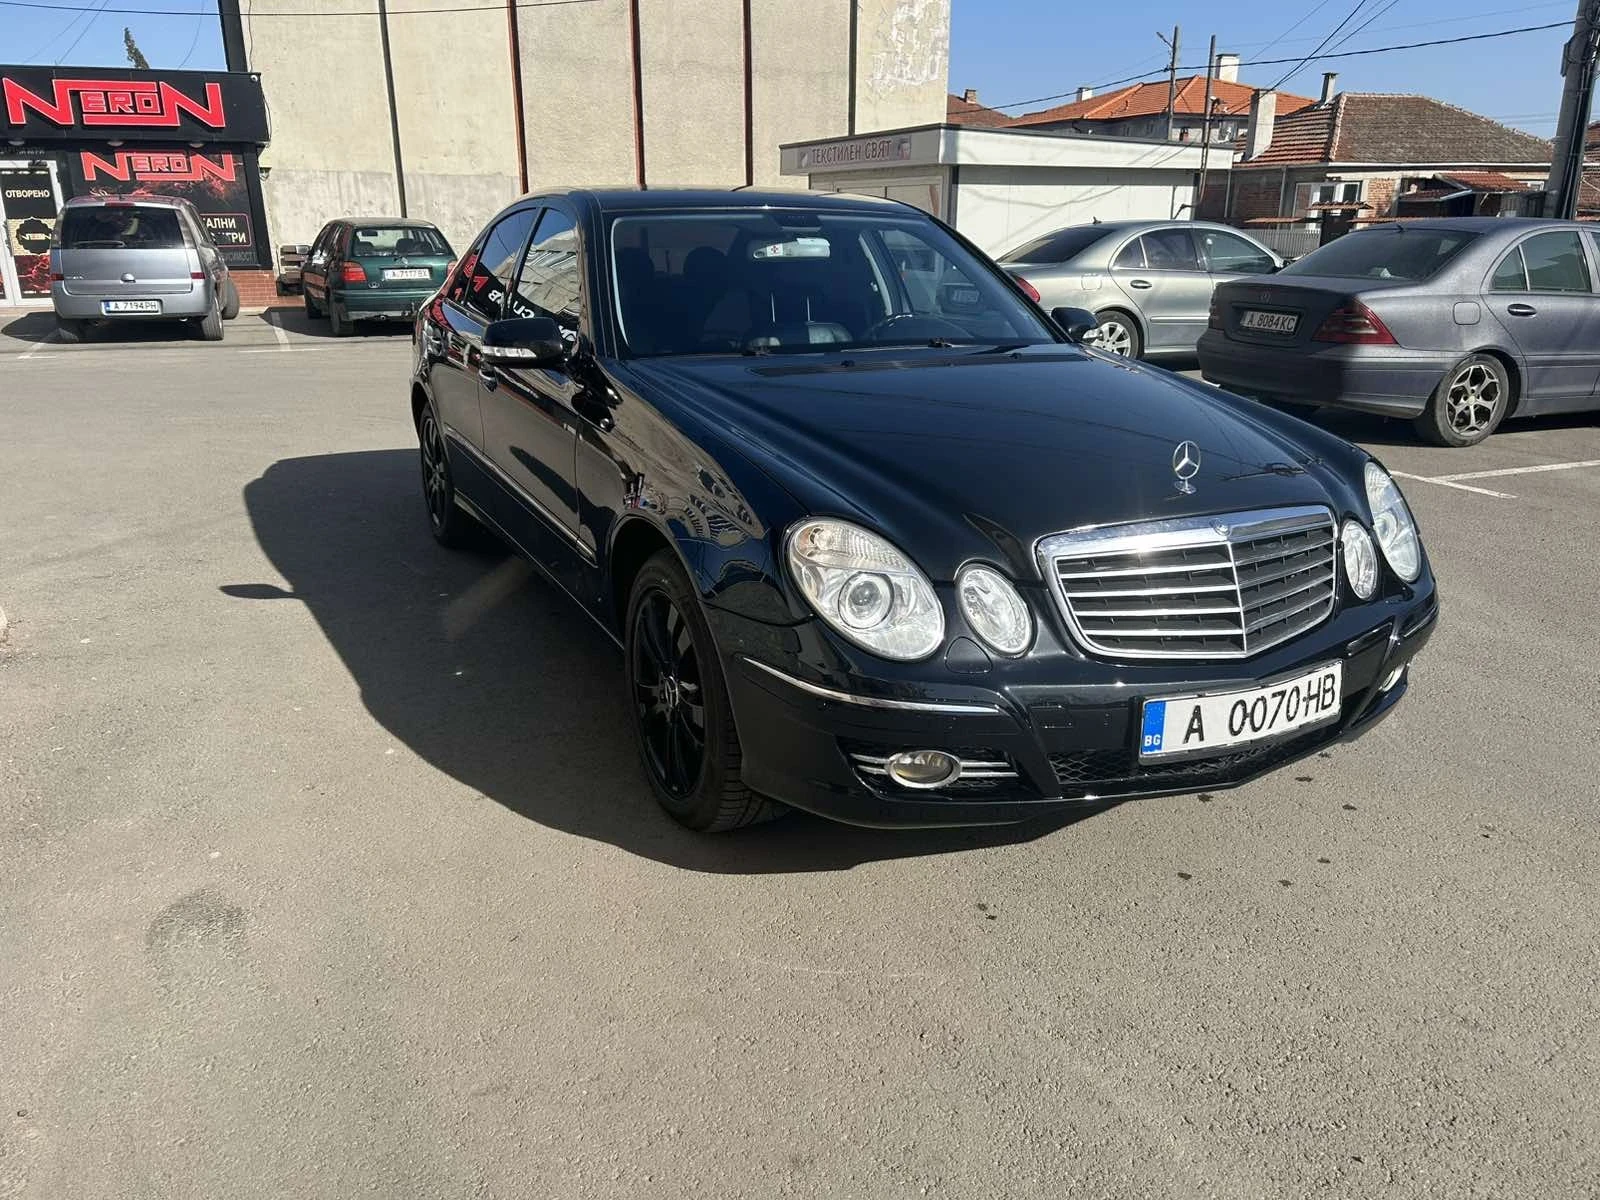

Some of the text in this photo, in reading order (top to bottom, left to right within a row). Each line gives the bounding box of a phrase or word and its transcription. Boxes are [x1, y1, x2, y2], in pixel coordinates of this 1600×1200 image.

[811, 140, 892, 164] ТЕКСТИЛЕН СВЯТ
[5, 189, 50, 198] ОТВОРЕНО
[1144, 734, 1161, 747] BG
